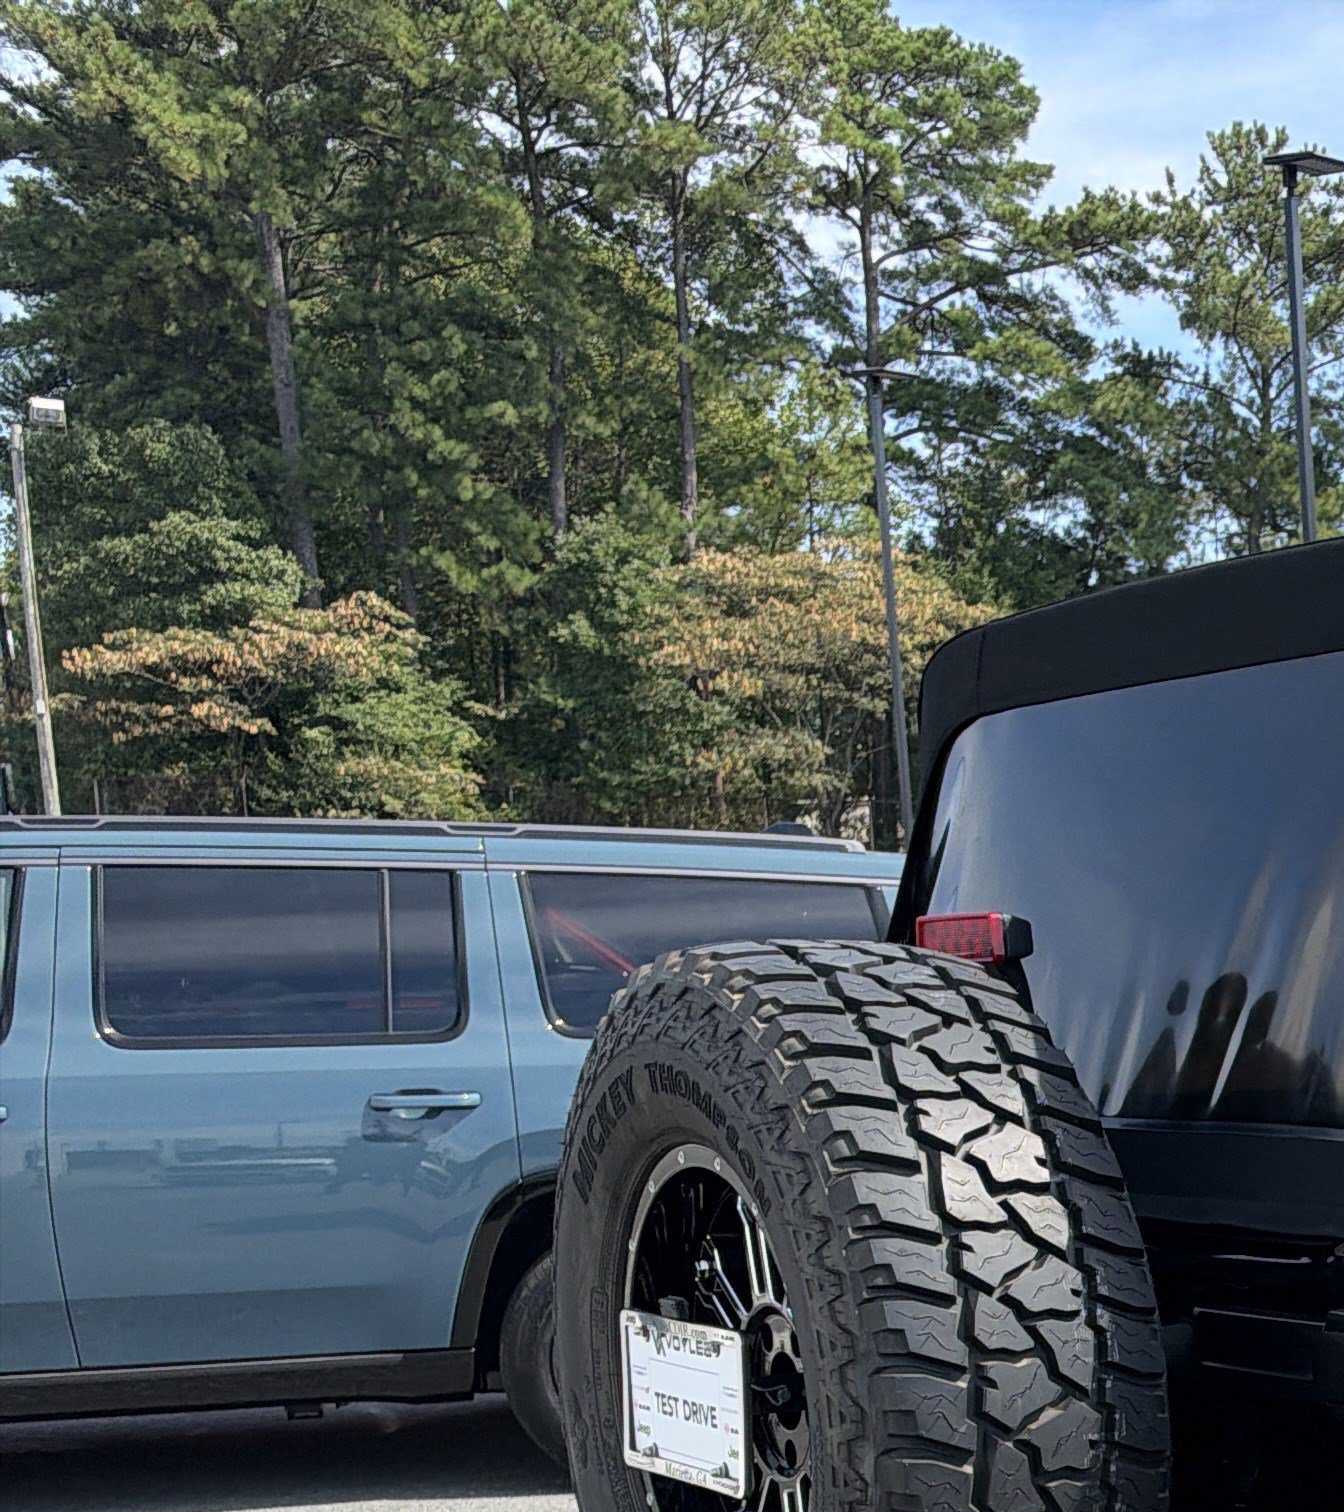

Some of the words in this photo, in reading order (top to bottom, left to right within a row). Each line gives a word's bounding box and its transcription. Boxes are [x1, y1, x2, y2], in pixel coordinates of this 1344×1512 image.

[572, 1064, 636, 1205] MICKEY
[643, 1060, 772, 1217] THOMPSON
[654, 1391, 679, 1419] TEST
[682, 1399, 718, 1429] DRIVE
